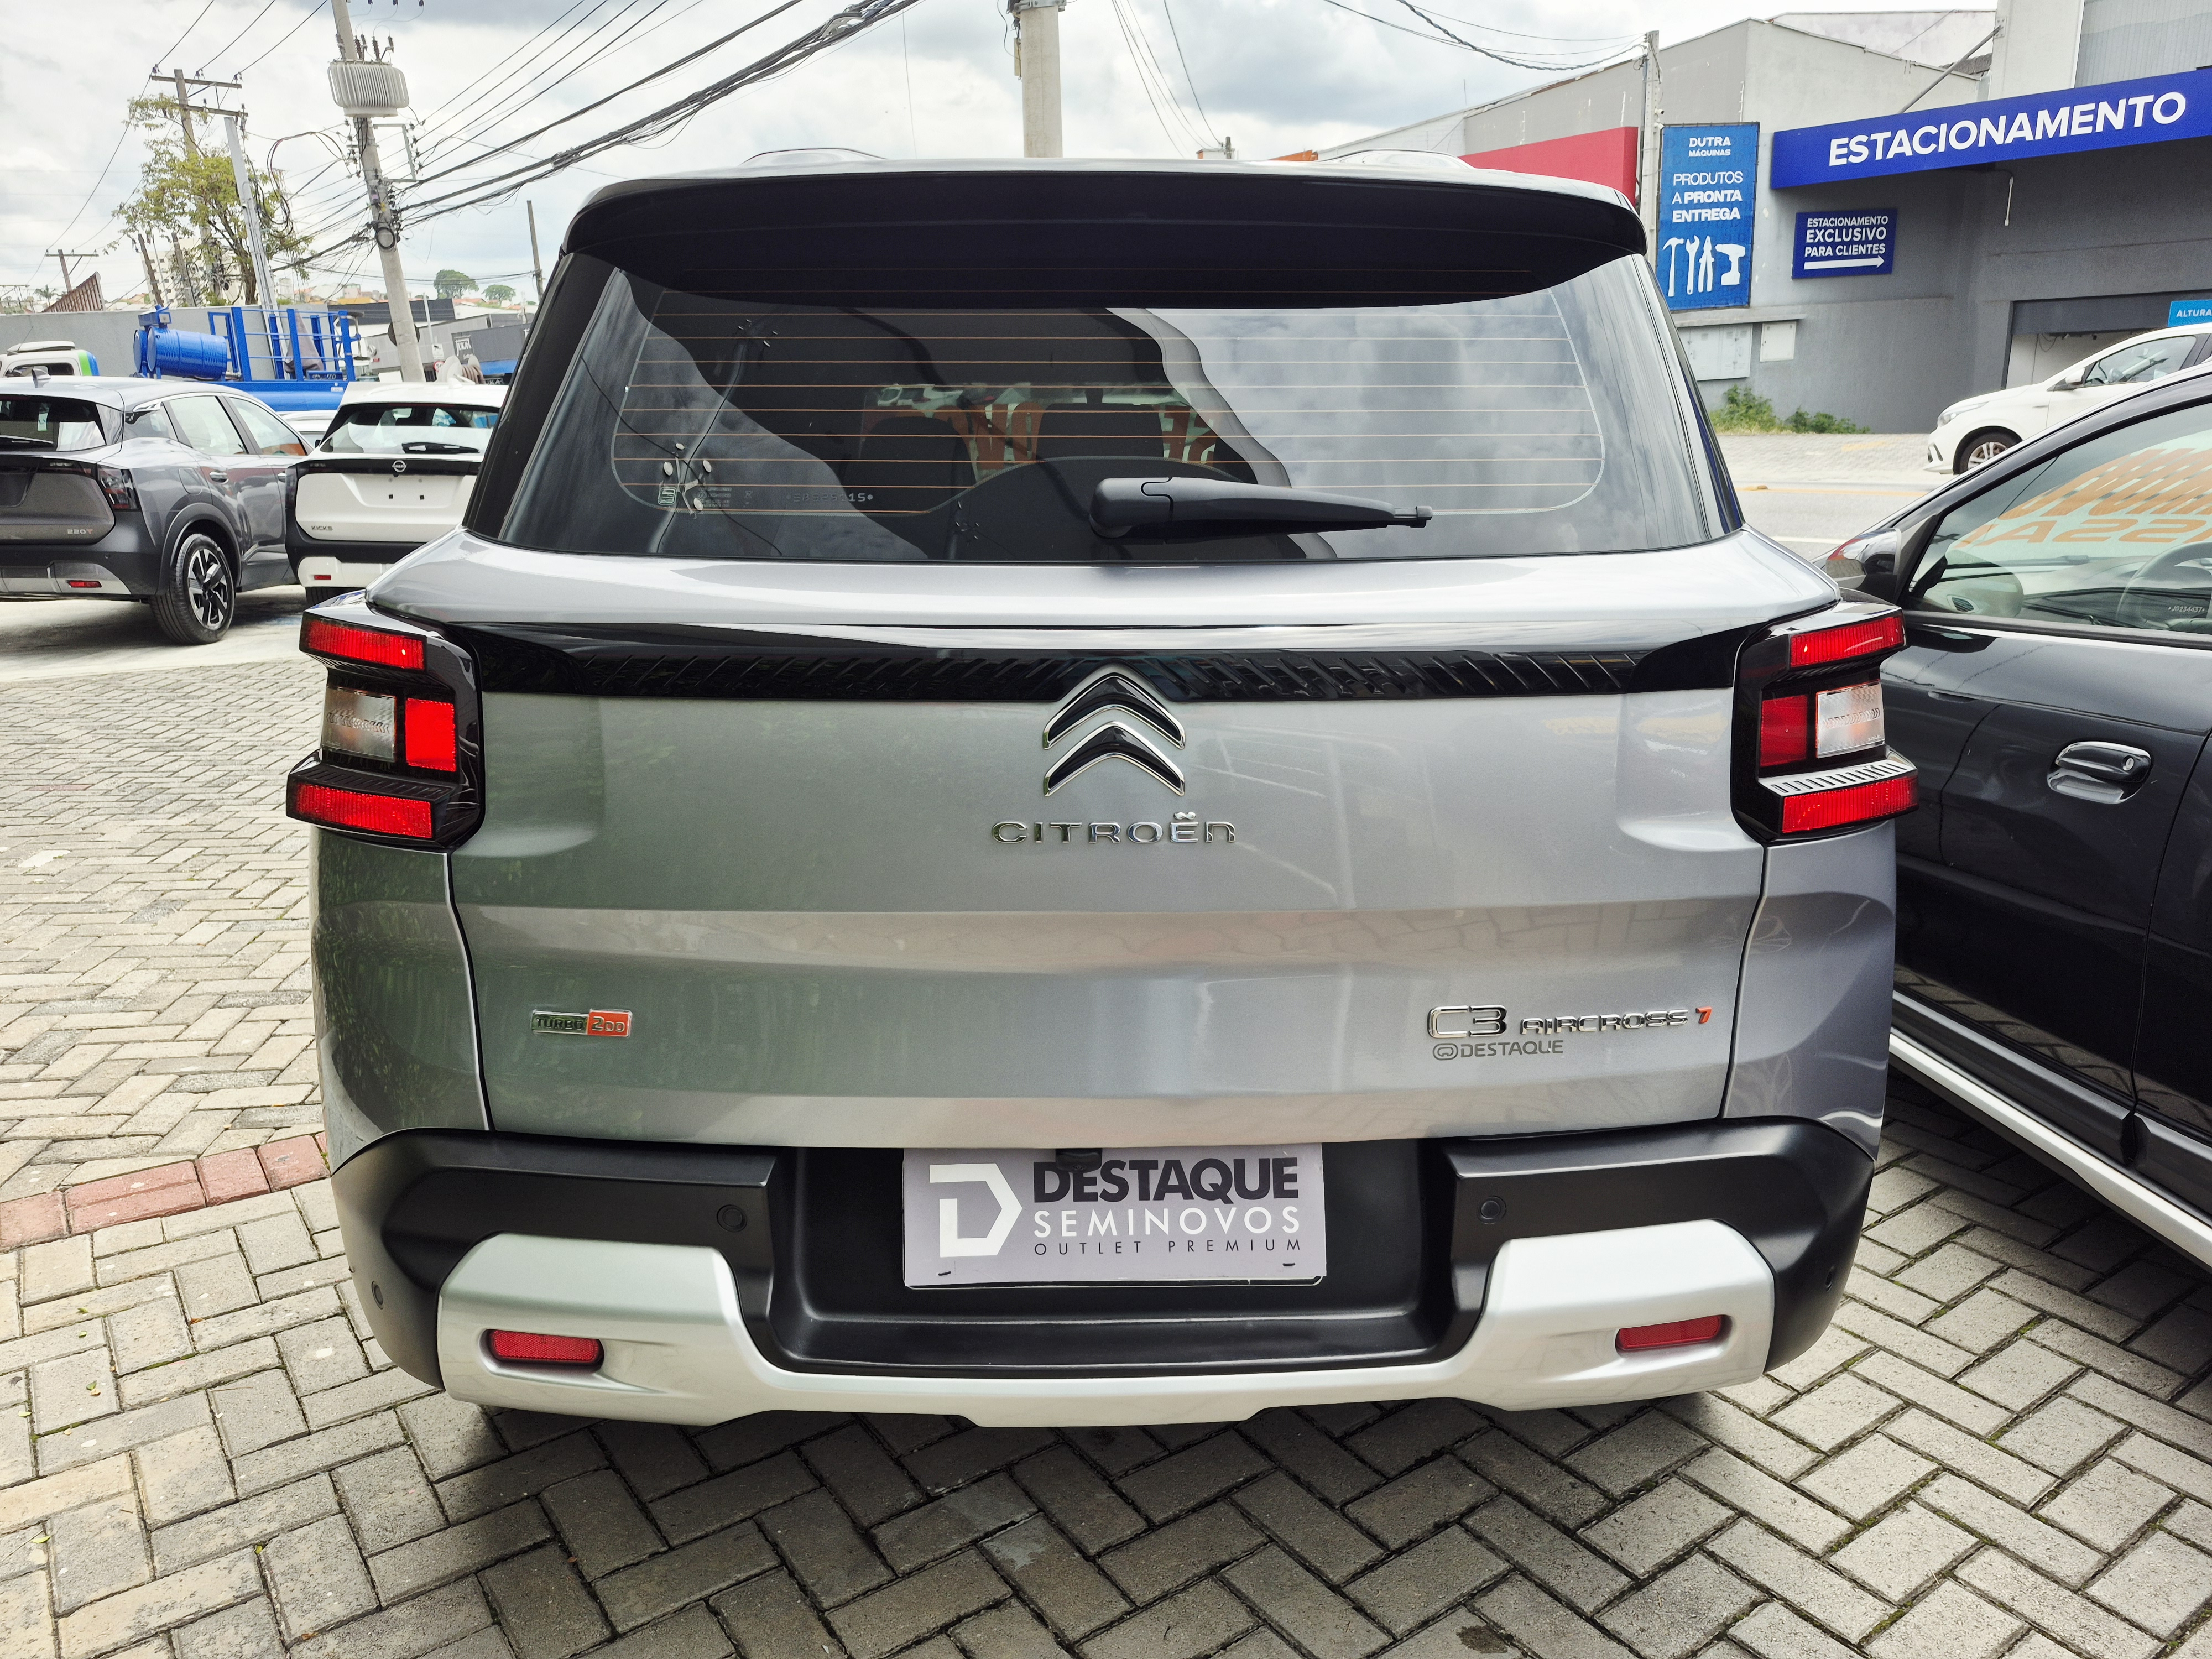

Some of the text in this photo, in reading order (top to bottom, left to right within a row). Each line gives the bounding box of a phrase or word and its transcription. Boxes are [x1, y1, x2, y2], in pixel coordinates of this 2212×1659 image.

[1828, 91, 2186, 166] ESTACIONAMENTO
[1689, 136, 1731, 148] DUTRA
[1688, 148, 1731, 157] MÁQUINAS
[1673, 171, 1743, 186] PRODUTOS
[1671, 189, 1743, 205] A PRONTA
[1672, 207, 1741, 223] ENTREGA
[1807, 215, 1888, 228] ESTACIONAMENTO
[1806, 226, 1887, 243] EXCLUSIVO
[1804, 243, 1886, 258] PARA CLIENTES
[2176, 308, 2212, 317] ALTURA
[536, 1016, 625, 1032] TURBO 200
[1426, 1004, 1507, 1039] C3
[1520, 1009, 1688, 1035] AIRCROSS
[1460, 1040, 1564, 1057] DESTAQUE
[1033, 1157, 1299, 1204] DESTAQUE
[1034, 1206, 1300, 1238] SEMINOVOS
[1034, 1238, 1301, 1255] OUTLET PREMIUM
